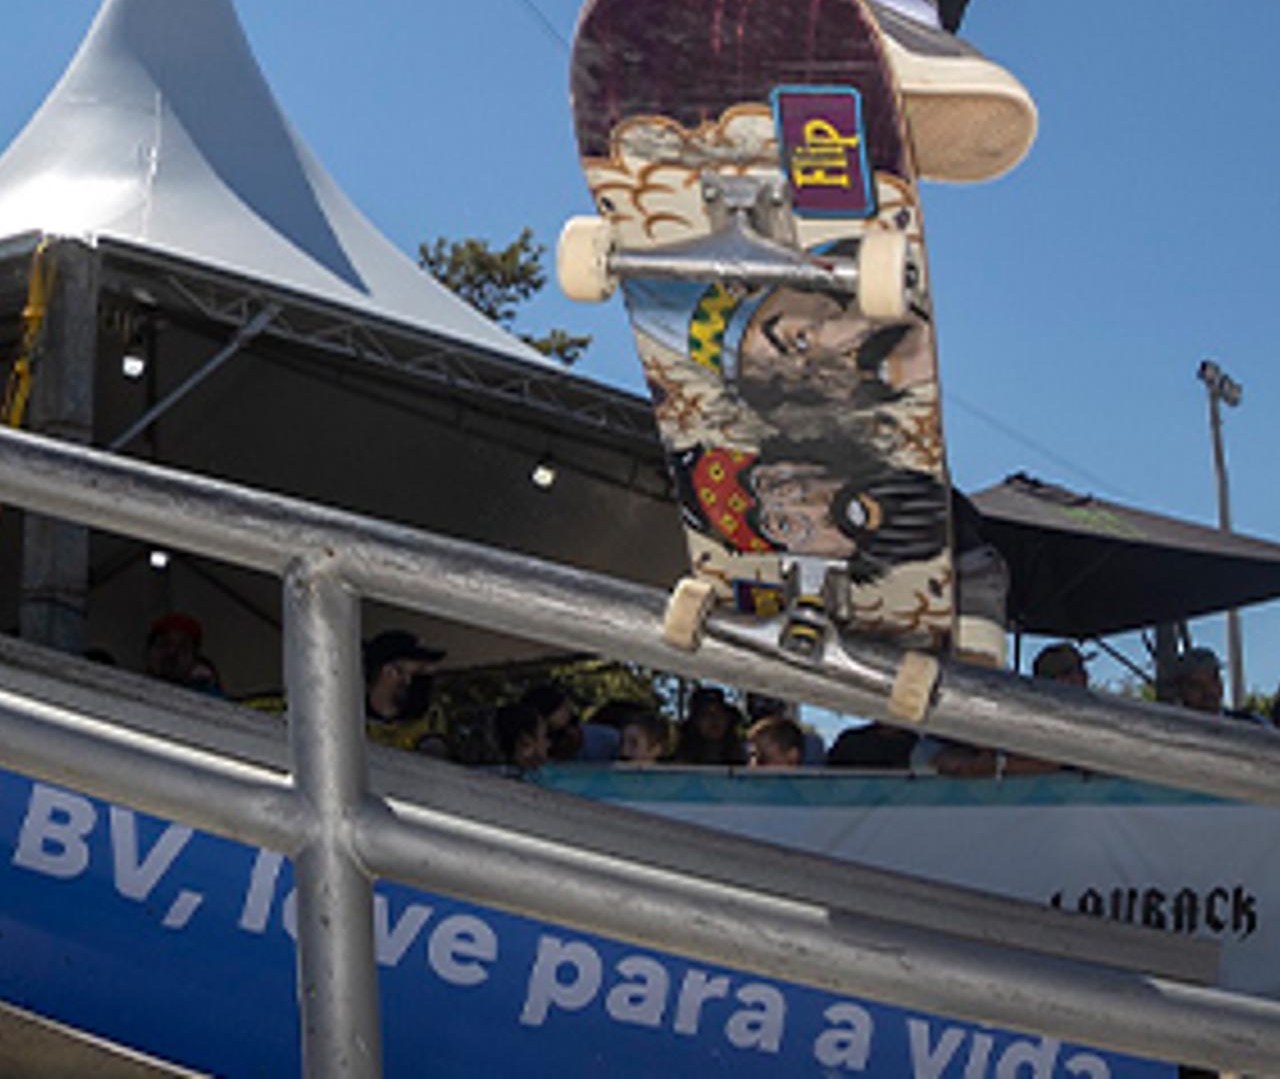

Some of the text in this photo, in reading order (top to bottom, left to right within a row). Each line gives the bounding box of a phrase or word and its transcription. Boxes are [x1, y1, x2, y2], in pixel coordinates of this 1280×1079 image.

[791, 118, 860, 187] Flip
[11, 782, 203, 929] BV,
[239, 848, 498, 985] lve
[520, 932, 787, 1055] para
[814, 1002, 874, 1071] a
